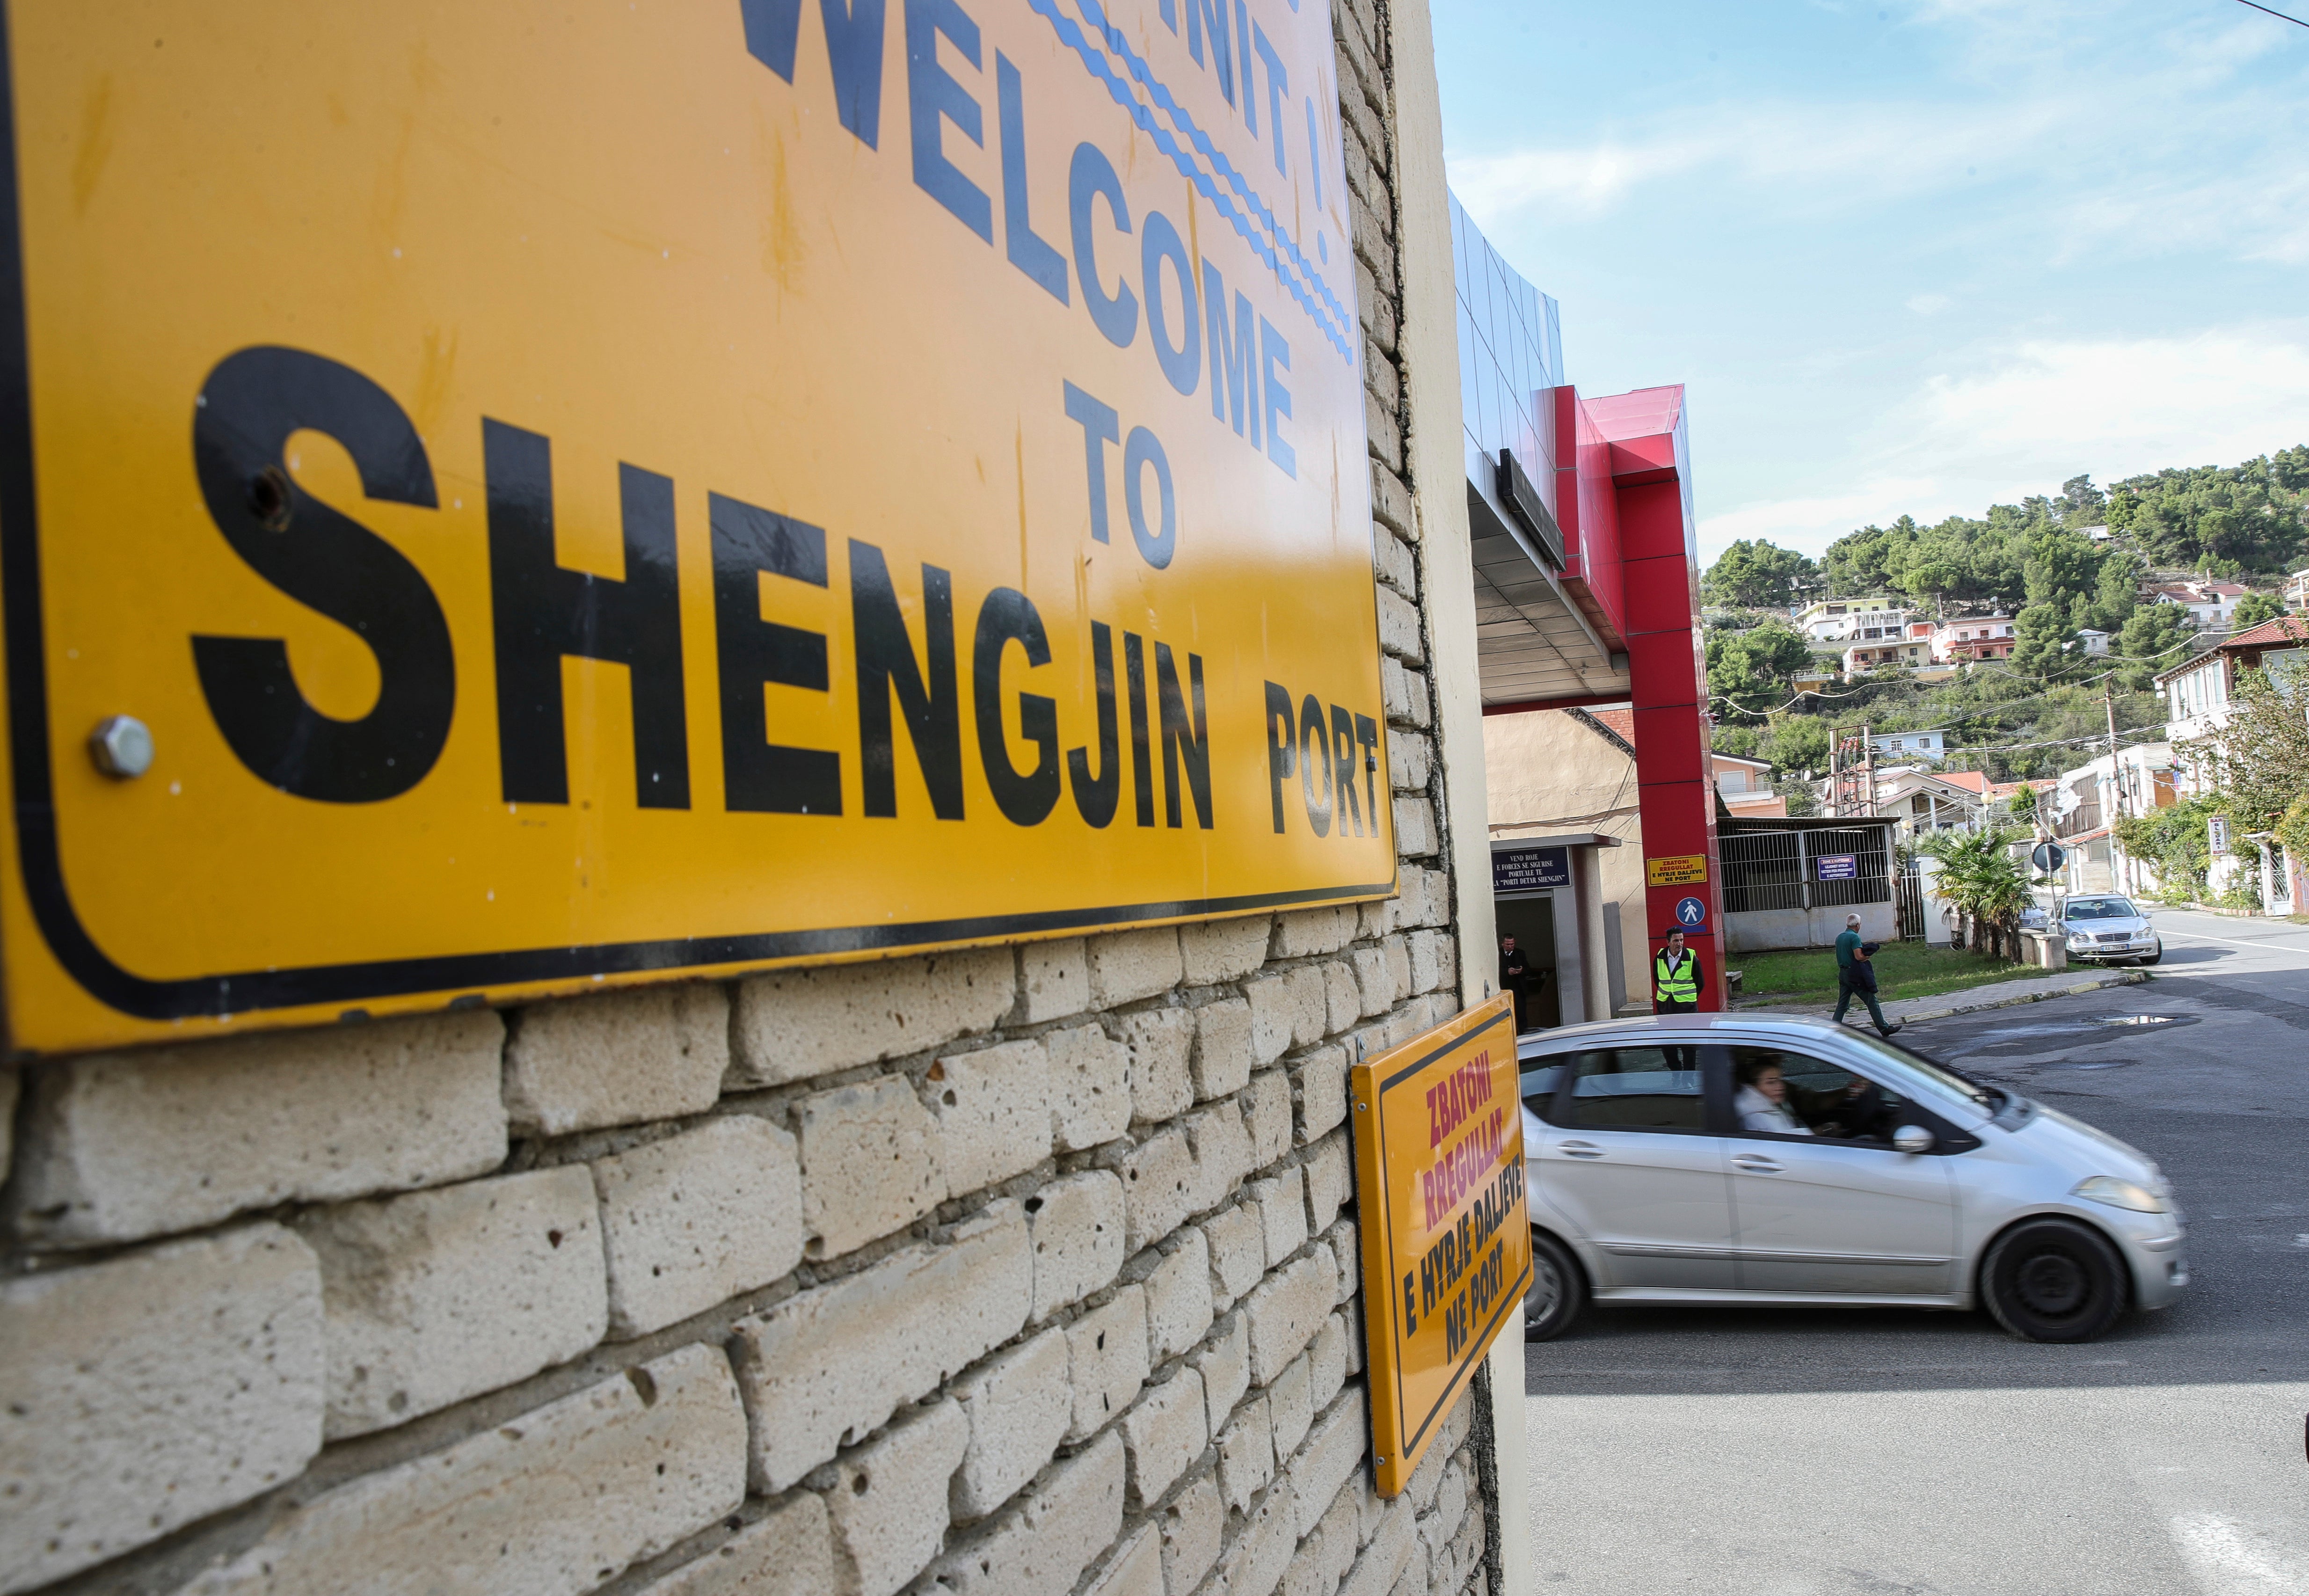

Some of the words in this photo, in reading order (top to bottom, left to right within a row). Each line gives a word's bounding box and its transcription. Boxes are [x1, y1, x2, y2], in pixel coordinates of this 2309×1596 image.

[1063, 378, 1175, 569] TO
[189, 345, 1214, 829] SHENGJIN
[1264, 679, 1379, 838] PORT
[1423, 1106, 1503, 1233] RREGULLAT
[1426, 1049, 1492, 1150] ZBATONI
[1404, 1270, 1417, 1340] E
[1420, 1210, 1471, 1319] HYRJE
[1473, 1152, 1522, 1254] DALJEVE
[1445, 1288, 1468, 1366] NE
[1470, 1237, 1503, 1331] PORT
